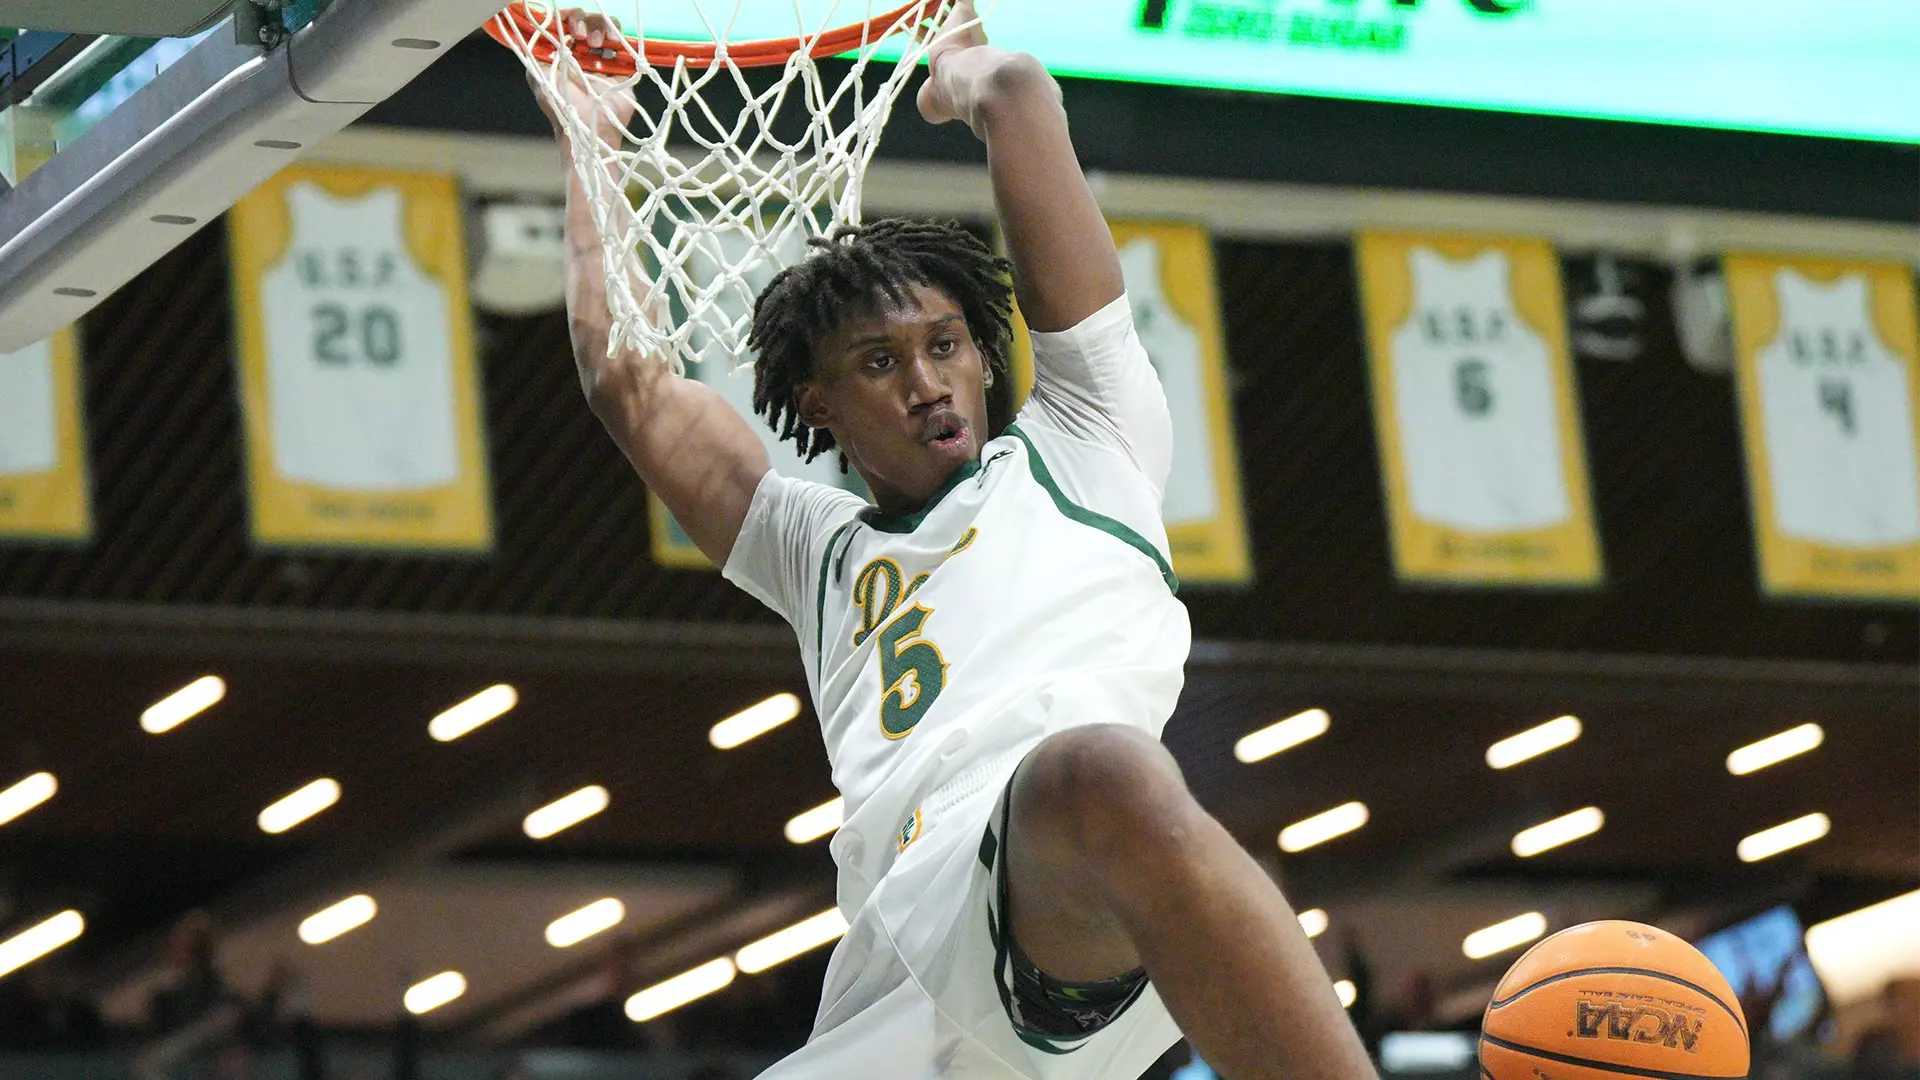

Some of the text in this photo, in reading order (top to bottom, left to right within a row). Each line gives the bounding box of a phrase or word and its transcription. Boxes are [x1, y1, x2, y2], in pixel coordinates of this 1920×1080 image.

[312, 302, 402, 366] 20
[1455, 359, 1496, 415] 6
[1817, 377, 1857, 436] 4
[877, 601, 951, 741] 5
[1577, 1000, 1705, 1054] NCAA
[1579, 990, 1706, 1014] OFFICIAL GAME BALL
